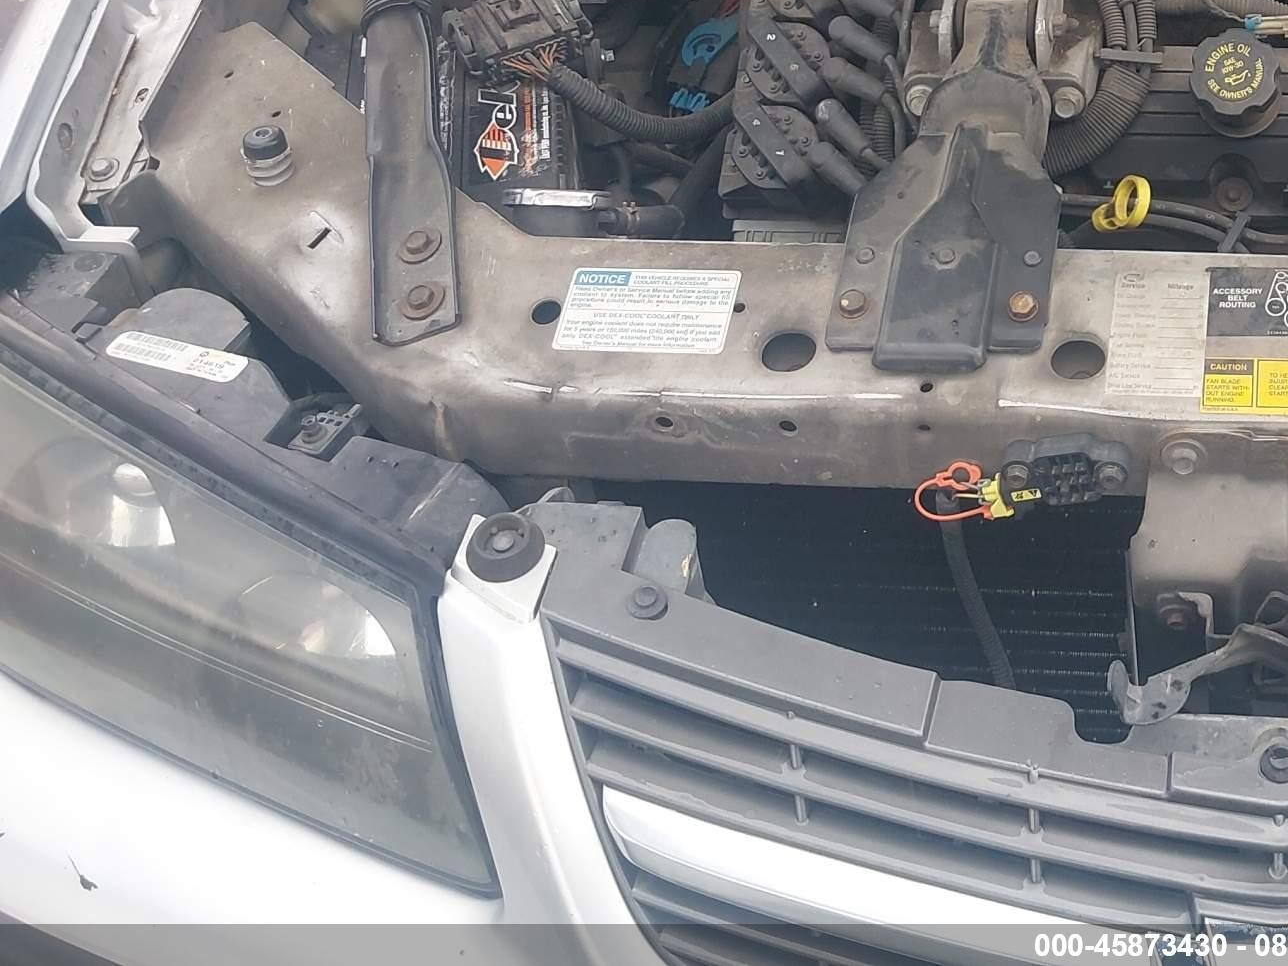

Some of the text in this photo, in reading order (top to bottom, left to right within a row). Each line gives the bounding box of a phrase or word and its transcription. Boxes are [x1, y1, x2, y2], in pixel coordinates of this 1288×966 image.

[1205, 43, 1252, 73] ENGINE OIL
[579, 273, 627, 284] NOTICE
[1218, 301, 1257, 309] ROUTING
[1210, 363, 1248, 371] CAUTION
